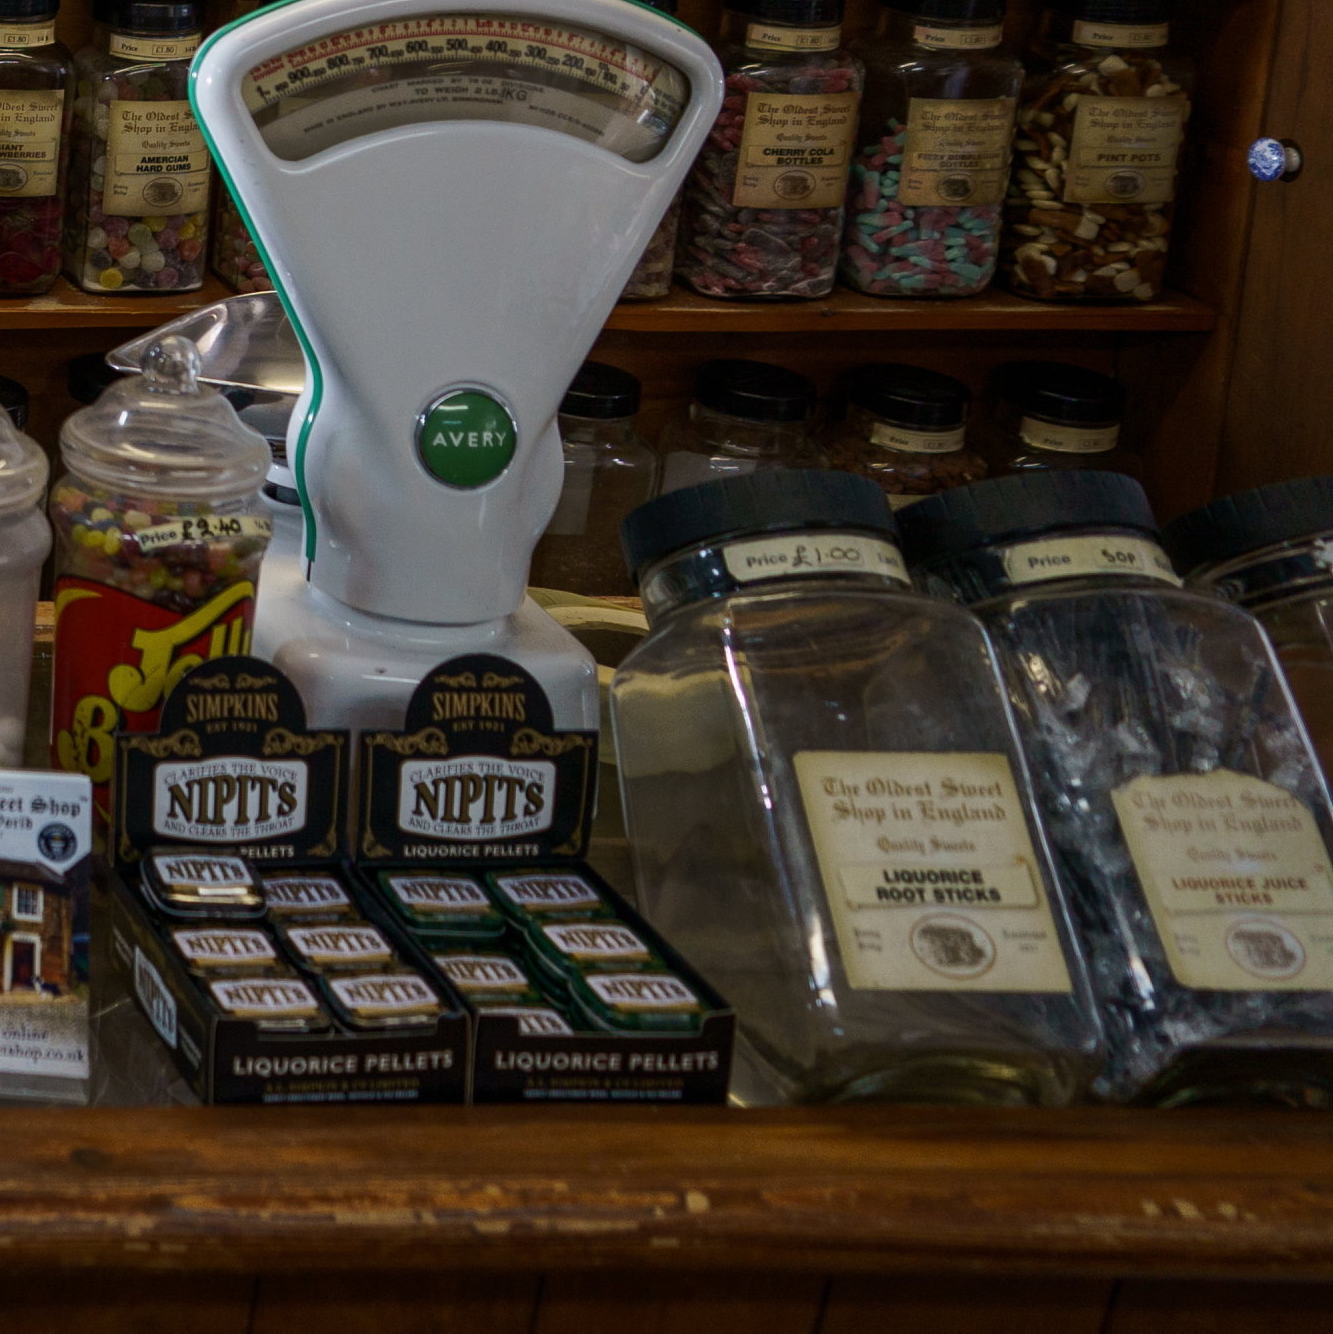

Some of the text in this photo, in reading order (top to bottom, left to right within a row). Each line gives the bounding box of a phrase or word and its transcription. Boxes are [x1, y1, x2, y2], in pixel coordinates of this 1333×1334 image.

[136, 162, 191, 173] HARD GUMS
[141, 156, 189, 164] AMERCIAN
[433, 432, 507, 450] AVERY
[140, 517, 242, 547] Price £2.40
[187, 693, 278, 723] SIMPKINS
[433, 693, 525, 723] SIMPKINS
[30, 796, 81, 817] Shop
[168, 775, 298, 824] NIPITS
[412, 773, 543, 823] NIPITS
[883, 869, 983, 885] LIQUORICE
[876, 887, 1001, 903] ROOT STICKS
[234, 1050, 453, 1075] LIQUORICE PELLETS
[495, 1051, 718, 1071] LIQUORICE PELLETS
